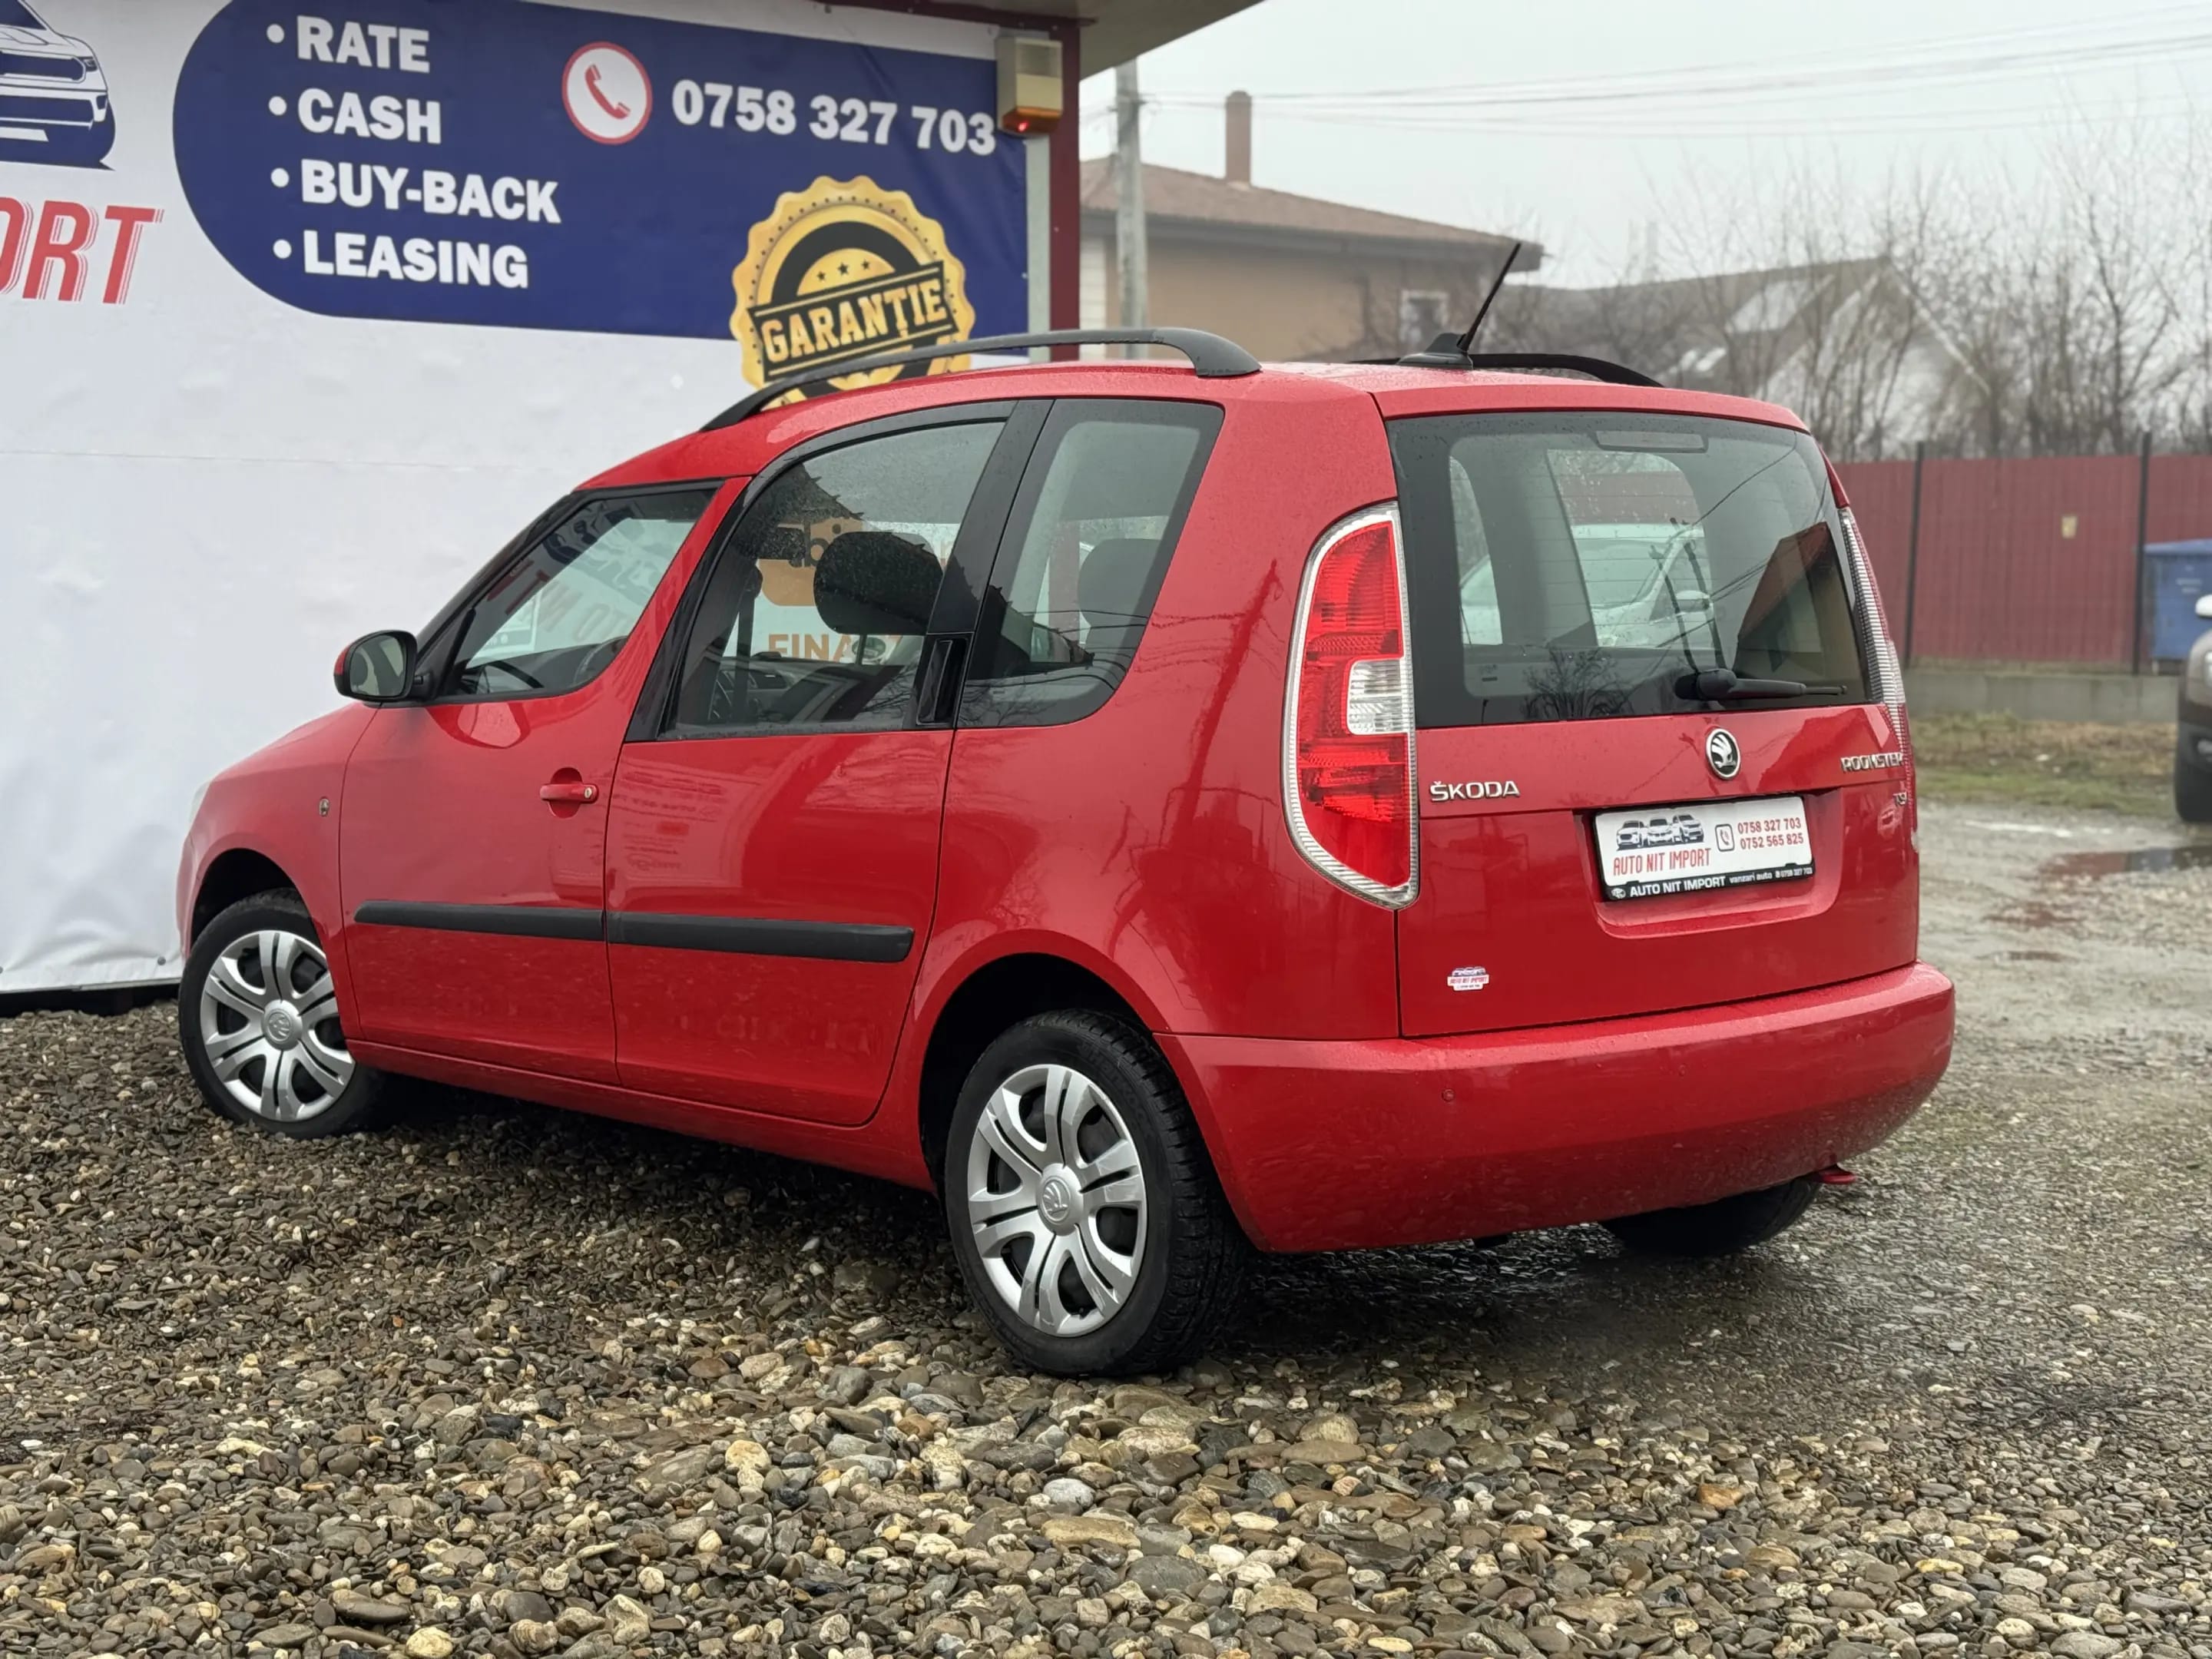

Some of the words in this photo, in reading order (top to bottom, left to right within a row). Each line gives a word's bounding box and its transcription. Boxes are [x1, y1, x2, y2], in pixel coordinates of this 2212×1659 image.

[298, 15, 430, 73] RATE
[298, 88, 442, 144] CASH
[672, 79, 796, 135] 0758
[809, 95, 898, 145] 327
[911, 106, 995, 156] 703
[302, 158, 561, 224] BUY-BACK
[304, 230, 529, 289] LEASING
[1429, 780, 1520, 802] ŠKODA
[1737, 821, 1762, 834] 0758
[1764, 819, 1780, 832] 327
[1783, 816, 1802, 830] 703
[1740, 836, 1764, 849] 0752
[1766, 834, 1784, 847] 565
[1786, 832, 1803, 845] 825
[1613, 855, 1643, 876] AUTO
[1647, 853, 1665, 873] NIT
[1669, 848, 1711, 870] IMPORT
[1629, 884, 1660, 898] AUTO
[1663, 881, 1683, 893] NIT
[1684, 876, 1726, 891] IMPORT
